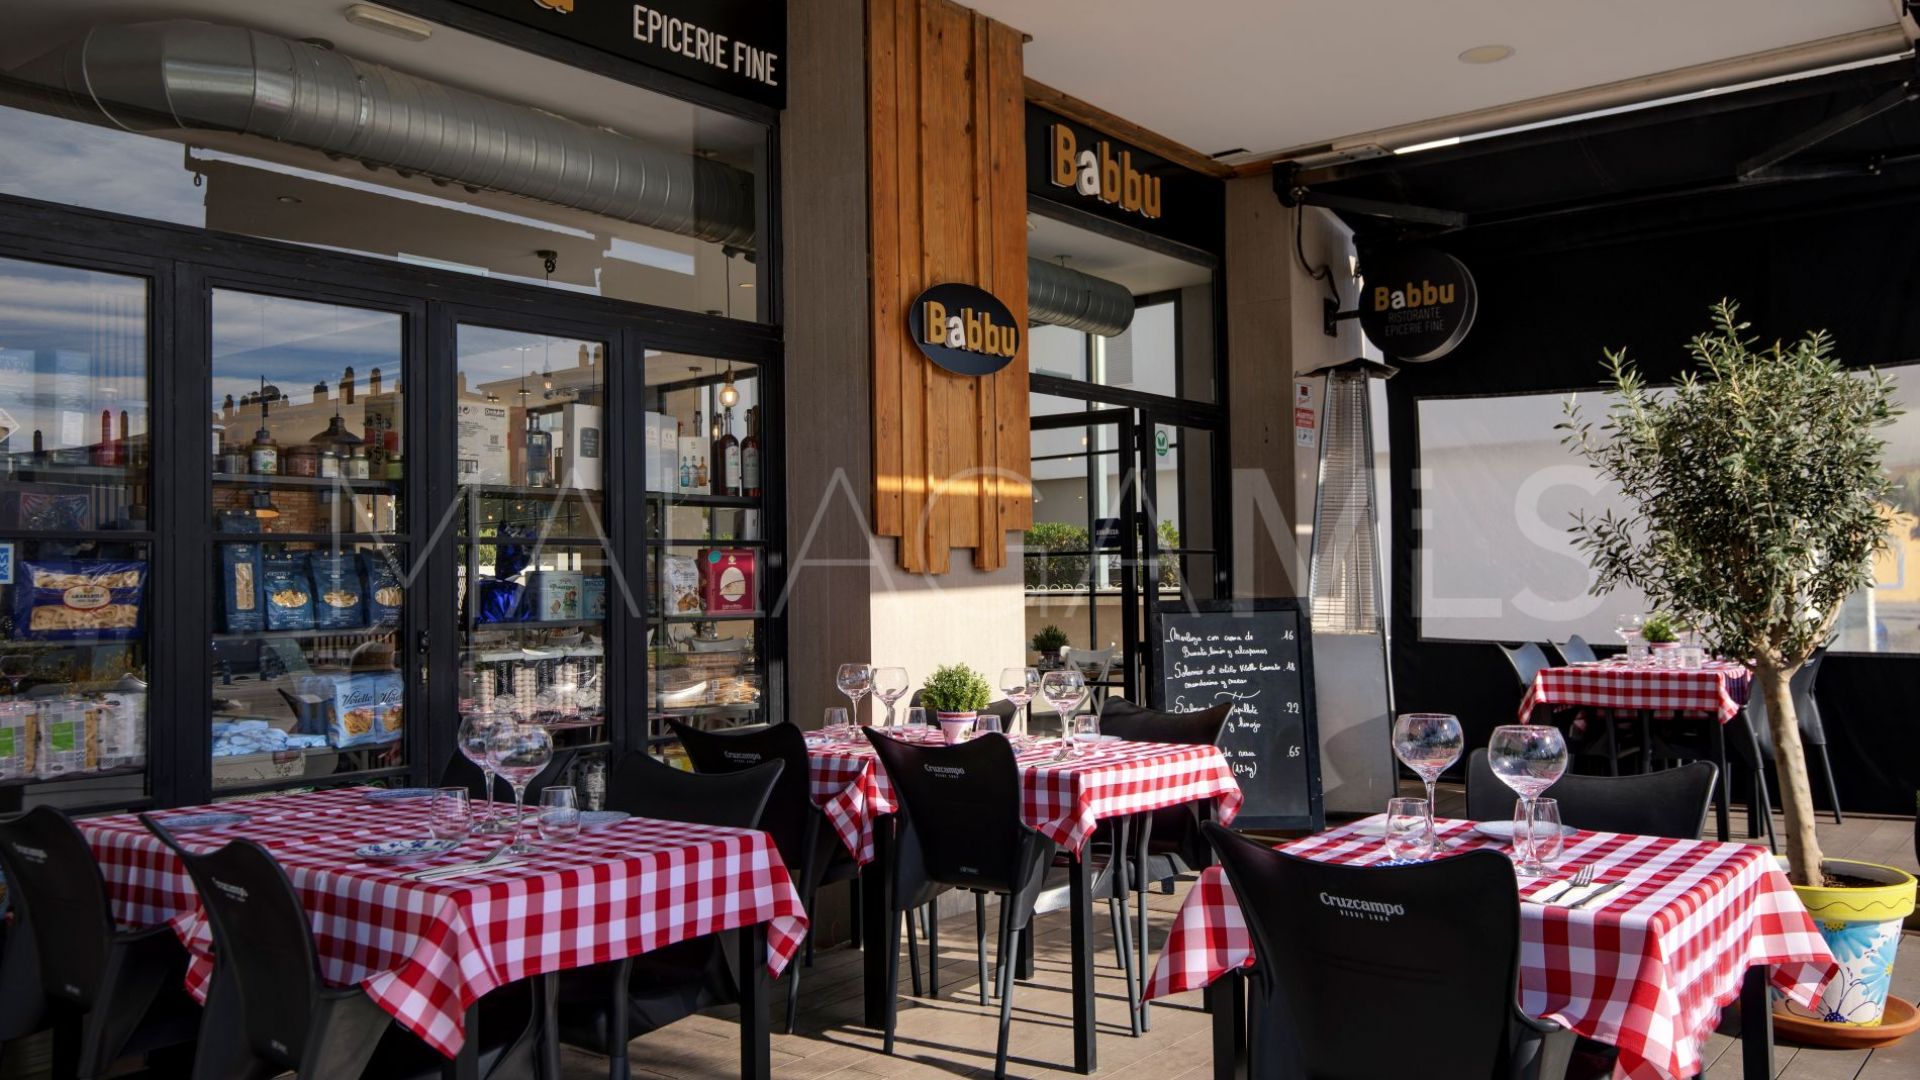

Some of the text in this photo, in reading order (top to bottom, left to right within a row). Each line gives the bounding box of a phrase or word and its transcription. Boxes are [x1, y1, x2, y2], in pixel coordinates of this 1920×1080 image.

[633, 4, 778, 86] EPICERIE FINE
[1051, 123, 1161, 219] Babbu
[1374, 280, 1455, 312] Babbu
[1388, 306, 1441, 322] RISTORANTE
[923, 300, 1016, 357] Babbu
[1385, 319, 1444, 337] EPICERIE FINE
[1245, 631, 1253, 641] de
[1227, 649, 1233, 658] y
[1227, 722, 1235, 733] y
[1319, 891, 1405, 916] Cruzcampo
